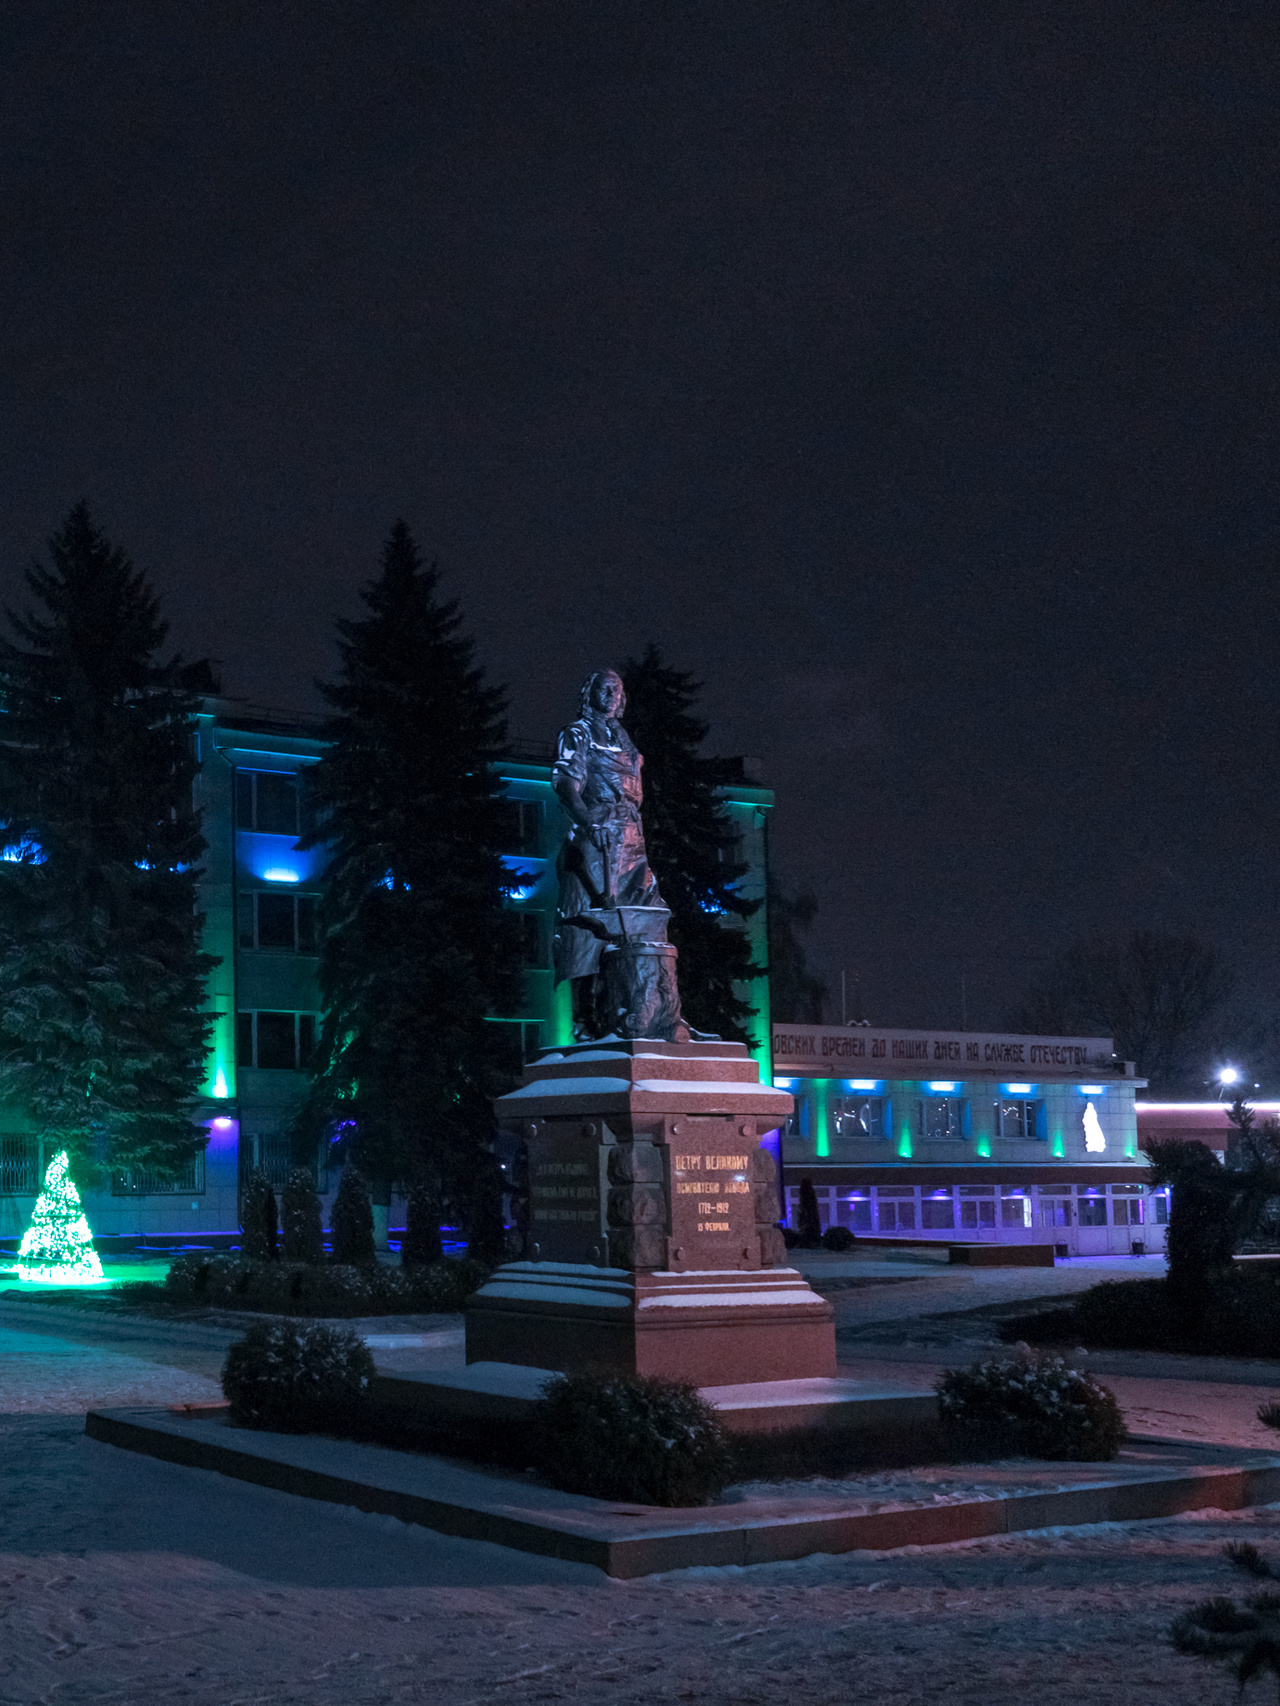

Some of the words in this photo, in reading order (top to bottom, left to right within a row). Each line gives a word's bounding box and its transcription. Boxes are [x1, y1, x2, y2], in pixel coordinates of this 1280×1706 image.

[821, 1036, 866, 1057] ВРЕМЕН
[872, 1038, 886, 1058] ДО
[891, 1039, 928, 1060] НАШИХ
[934, 1041, 961, 1061] ДНЕЙ
[966, 1042, 979, 1062] НА
[984, 1043, 1025, 1063] СЛУЖБЕ
[675, 1155, 702, 1170] ПЕТРУ
[705, 1155, 749, 1170] ВЕЛИКОМУ
